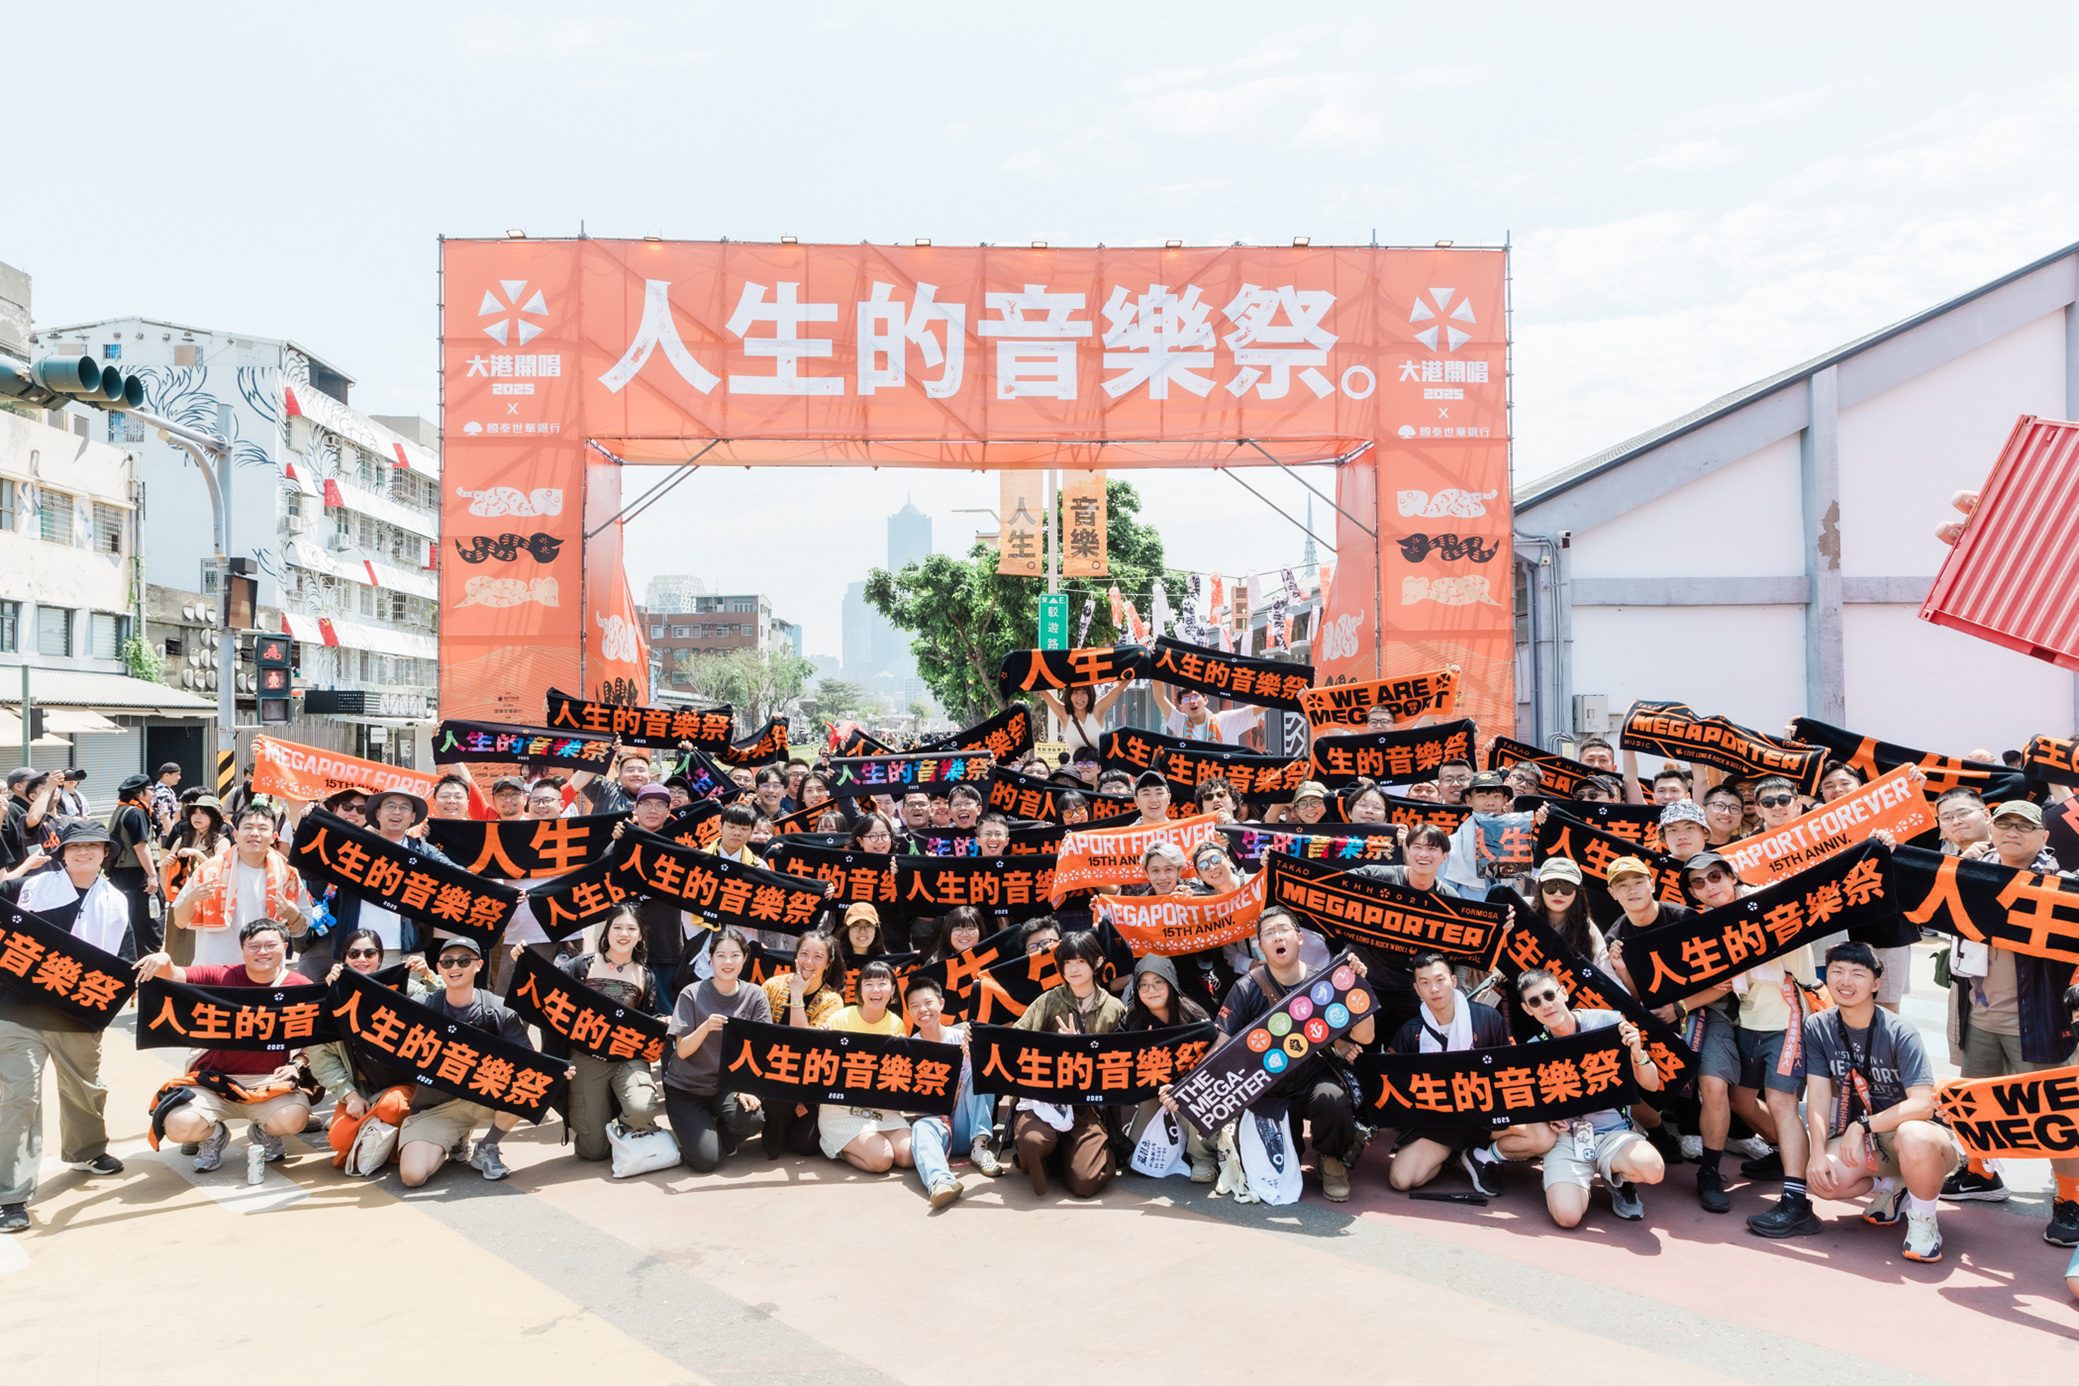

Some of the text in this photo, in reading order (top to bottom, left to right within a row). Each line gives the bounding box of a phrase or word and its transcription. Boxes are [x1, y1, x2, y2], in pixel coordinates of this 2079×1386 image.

[597, 278, 1376, 400] 人生的音樂祭。
[466, 354, 561, 378] 大港開唱
[1398, 360, 1489, 383] 大港開唱
[492, 383, 535, 395] 2025
[1423, 388, 1464, 400] 2025
[1155, 647, 1309, 701] 人生的音樂祭
[1329, 688, 1371, 709] WE
[1377, 677, 1430, 703] ARE
[553, 700, 731, 741] 人生的音樂祭
[439, 729, 612, 764] 人生的音樂祭
[1630, 714, 1803, 771] MEGAPORTER
[836, 756, 991, 786] 人生的音樂祭
[1809, 776, 1913, 843] FOREVER
[1088, 856, 1117, 867] 15TH
[1276, 859, 1310, 876] TAKAO
[1768, 833, 1853, 873] 15TH ANNIV.
[300, 826, 509, 932] 人生的音樂祭
[618, 843, 822, 925] 人生的音樂祭
[1098, 900, 1200, 927] MEGAPORT
[1162, 916, 1236, 938] 15TH ANNIV.
[1281, 881, 1486, 948] MEGAPORTER
[1460, 906, 1499, 920] FORMOSA
[1648, 857, 1885, 994] 人生的音樂祭
[0, 928, 125, 1011] 音樂祭
[332, 989, 555, 1109] 人生的音樂祭
[416, 1073, 434, 1085] 2025
[728, 1038, 953, 1098] 人生的音樂祭
[1373, 1049, 1624, 1114] 人生的音樂祭
[828, 1092, 845, 1100] 2025
[1086, 1094, 1104, 1102] 2025
[1173, 1069, 1216, 1104] THE
[1200, 1069, 1273, 1131] PORTER
[1992, 1076, 2079, 1116] WE
[1492, 1117, 1511, 1125] 2025
